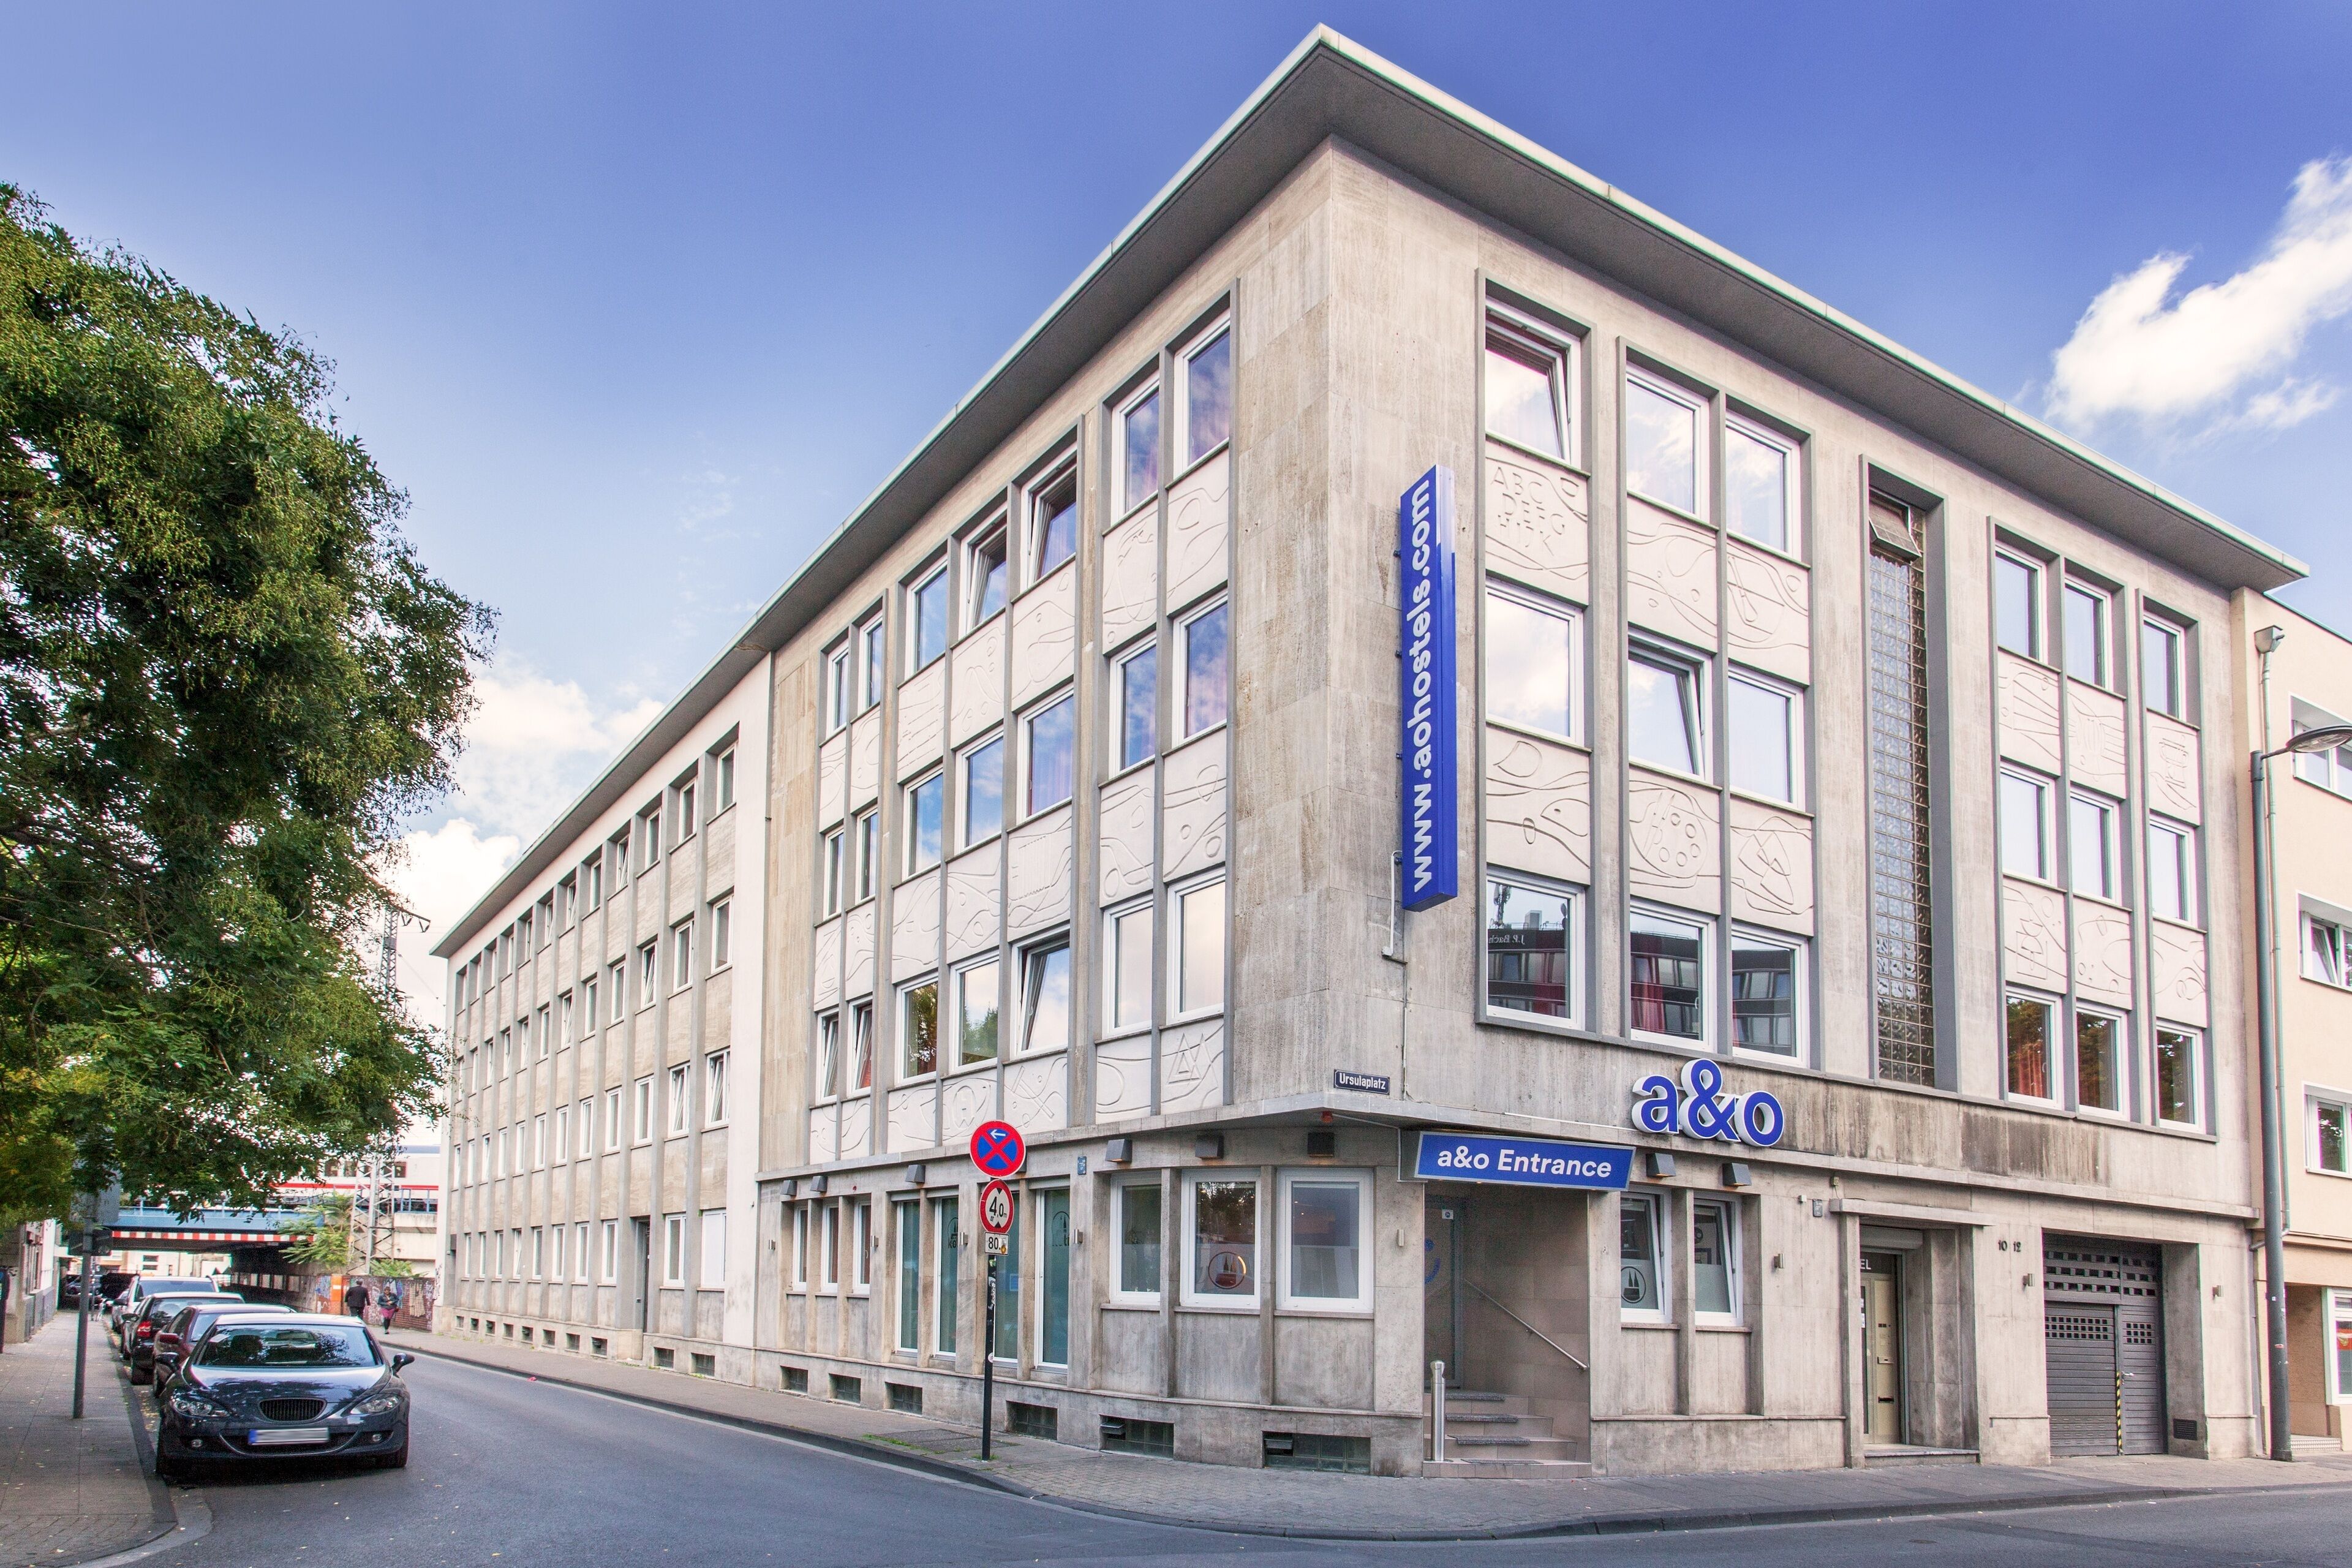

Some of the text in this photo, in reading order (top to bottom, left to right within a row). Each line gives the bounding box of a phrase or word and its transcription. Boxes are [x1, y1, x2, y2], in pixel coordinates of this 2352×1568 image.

[1406, 480, 1432, 892] www.aohostels.com
[1339, 1072, 1386, 1090] Ursulaplatz
[1631, 1058, 1785, 1147] a&o
[1437, 1145, 1612, 1178] a&o Entrance
[1998, 1240, 2021, 1253] 10 12
